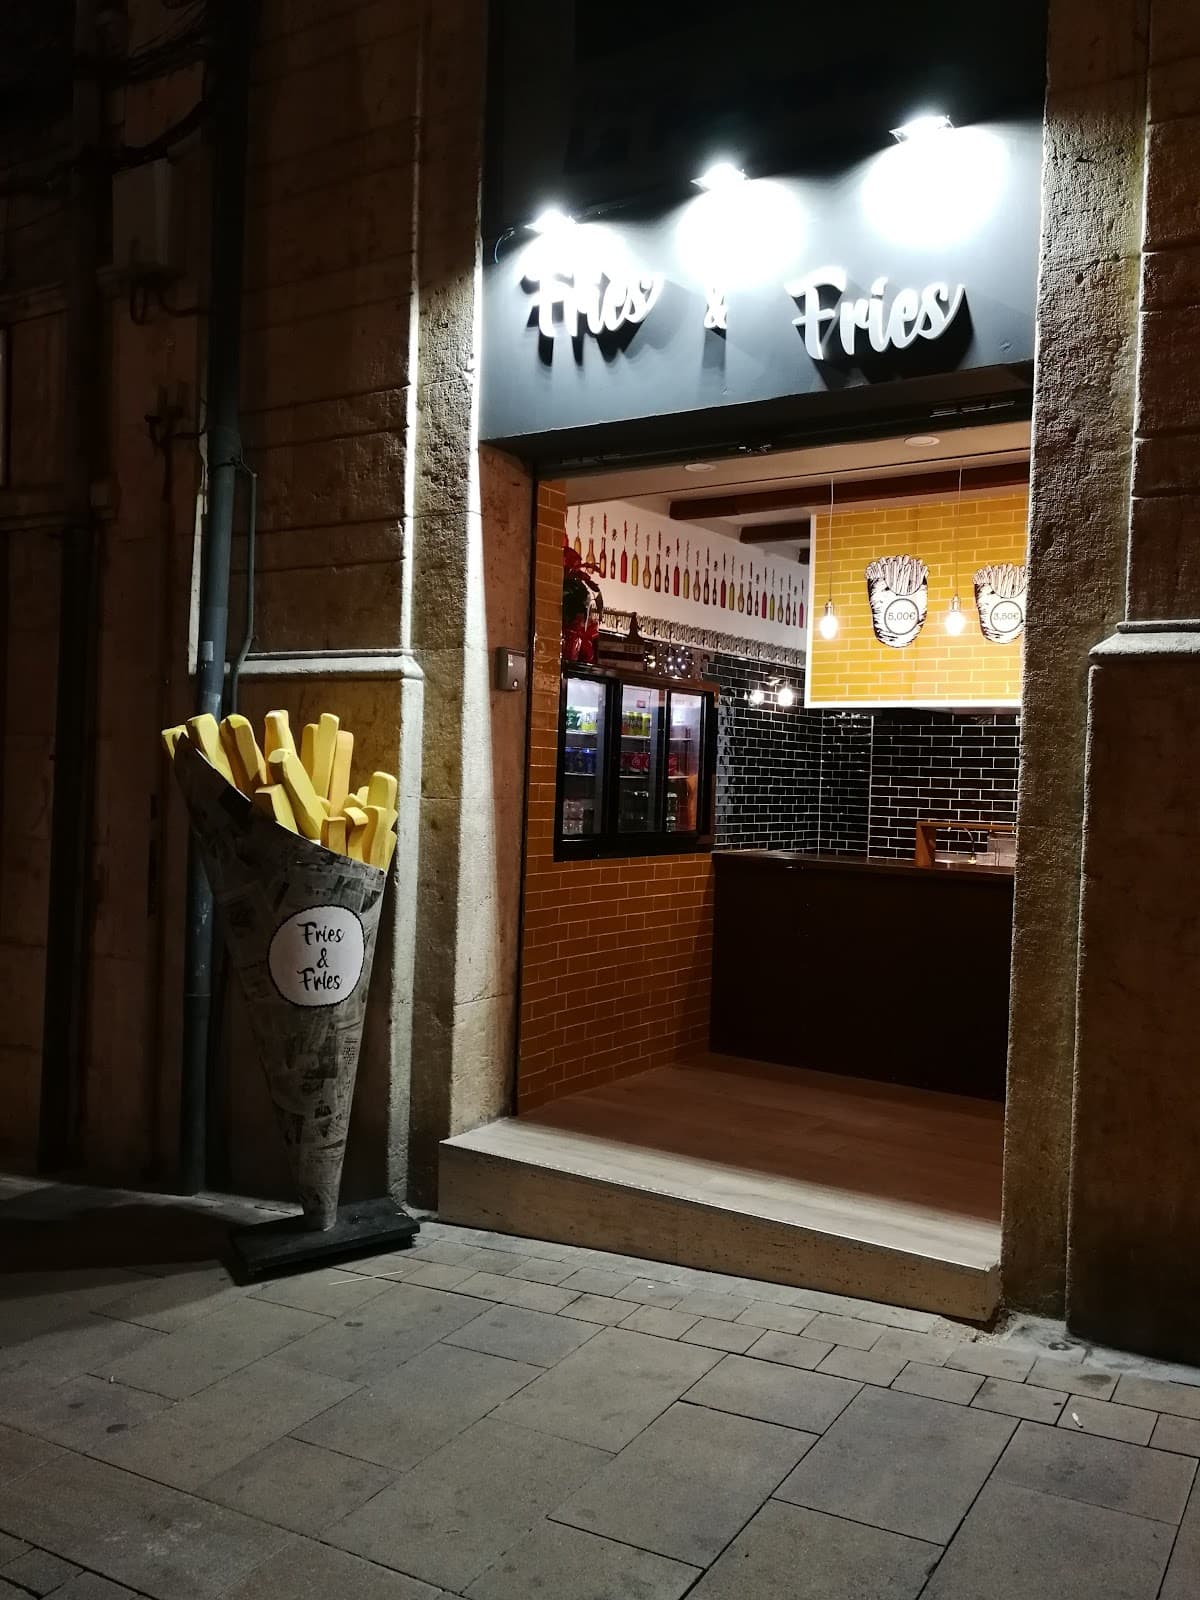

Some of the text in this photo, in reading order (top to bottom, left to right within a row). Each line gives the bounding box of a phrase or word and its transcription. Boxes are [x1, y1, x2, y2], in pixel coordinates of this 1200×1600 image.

[517, 262, 965, 360] Fries & Fries
[297, 922, 345, 945] Fries
[316, 948, 329, 969] &
[296, 967, 342, 991] Fries
